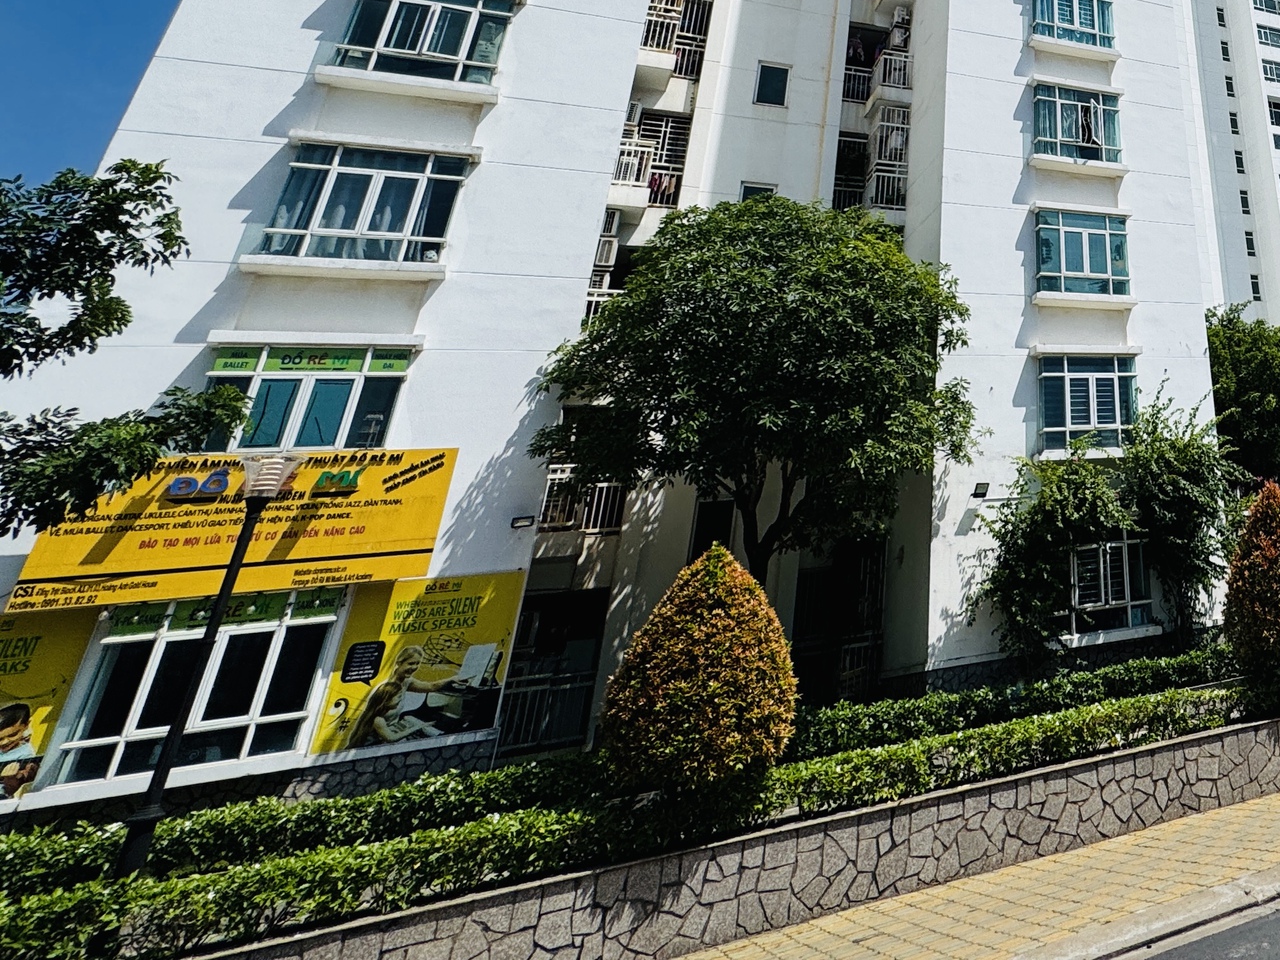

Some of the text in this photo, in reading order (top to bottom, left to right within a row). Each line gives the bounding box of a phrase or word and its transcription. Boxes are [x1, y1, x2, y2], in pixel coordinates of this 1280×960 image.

[222, 361, 250, 369] BALLET
[306, 352, 329, 365] RÊ
[208, 519, 228, 527] GIAO
[300, 513, 325, 522] K-POP
[138, 536, 158, 550] ĐÀO
[163, 537, 179, 550] TẠO
[182, 537, 201, 549] MỌI
[204, 533, 222, 545] LỨA
[265, 530, 279, 541] CƠ
[302, 526, 321, 538] ĐẾN
[323, 526, 345, 537] NÂNG
[349, 525, 366, 536] CAO
[13, 586, 36, 599] CS1
[393, 607, 427, 620] WORDS
[428, 606, 447, 617] ARE
[448, 595, 483, 616] SILENT
[396, 600, 421, 609] WHEN
[389, 616, 477, 633] MUSIC SPEAKS
[0, 635, 42, 658] ILENT
[0, 660, 31, 673] AKS
